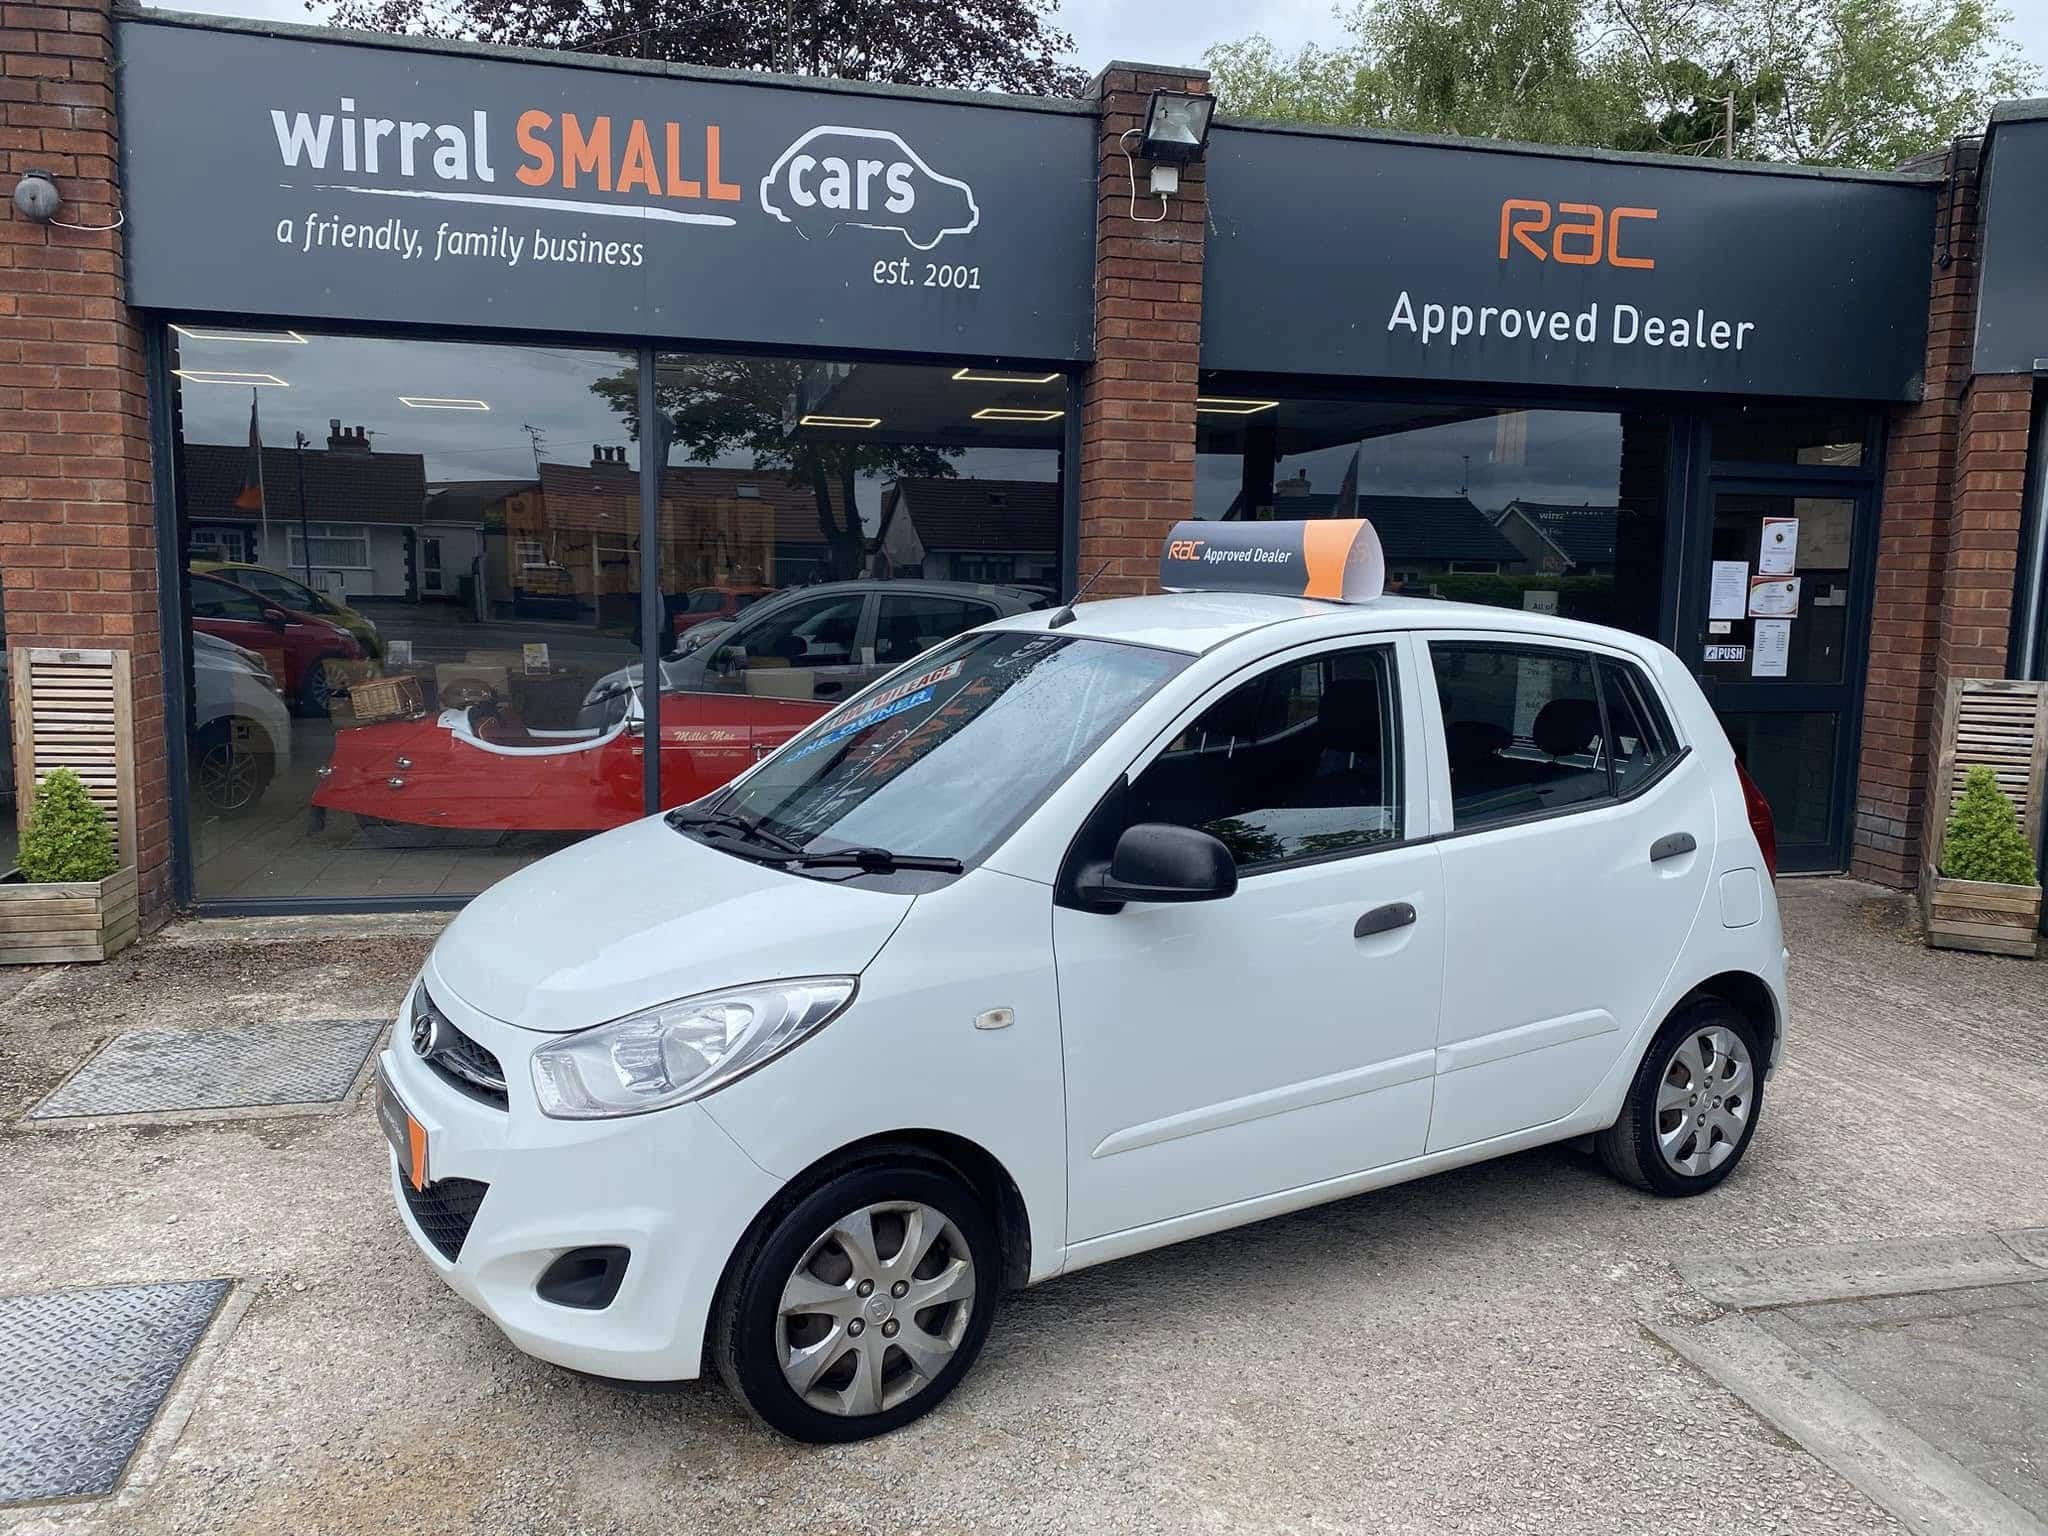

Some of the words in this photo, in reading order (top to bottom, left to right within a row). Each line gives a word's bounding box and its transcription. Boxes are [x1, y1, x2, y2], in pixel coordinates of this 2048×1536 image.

[270, 97, 495, 183] wirral
[516, 111, 741, 200] SMALL
[788, 153, 916, 214] cars
[276, 219, 293, 243] a
[303, 212, 423, 260] friendly,
[434, 222, 525, 267] family
[533, 228, 644, 266] business
[873, 256, 914, 286] est.
[923, 263, 982, 291] 2001
[1387, 291, 1598, 346] Approved
[1613, 304, 1755, 350] Dealer
[1203, 548, 1252, 564] Approved
[1253, 548, 1292, 564] Dealer
[1718, 647, 1743, 659] PUSH
[871, 664, 953, 708] MILEAGE
[838, 688, 928, 735] OWNER
